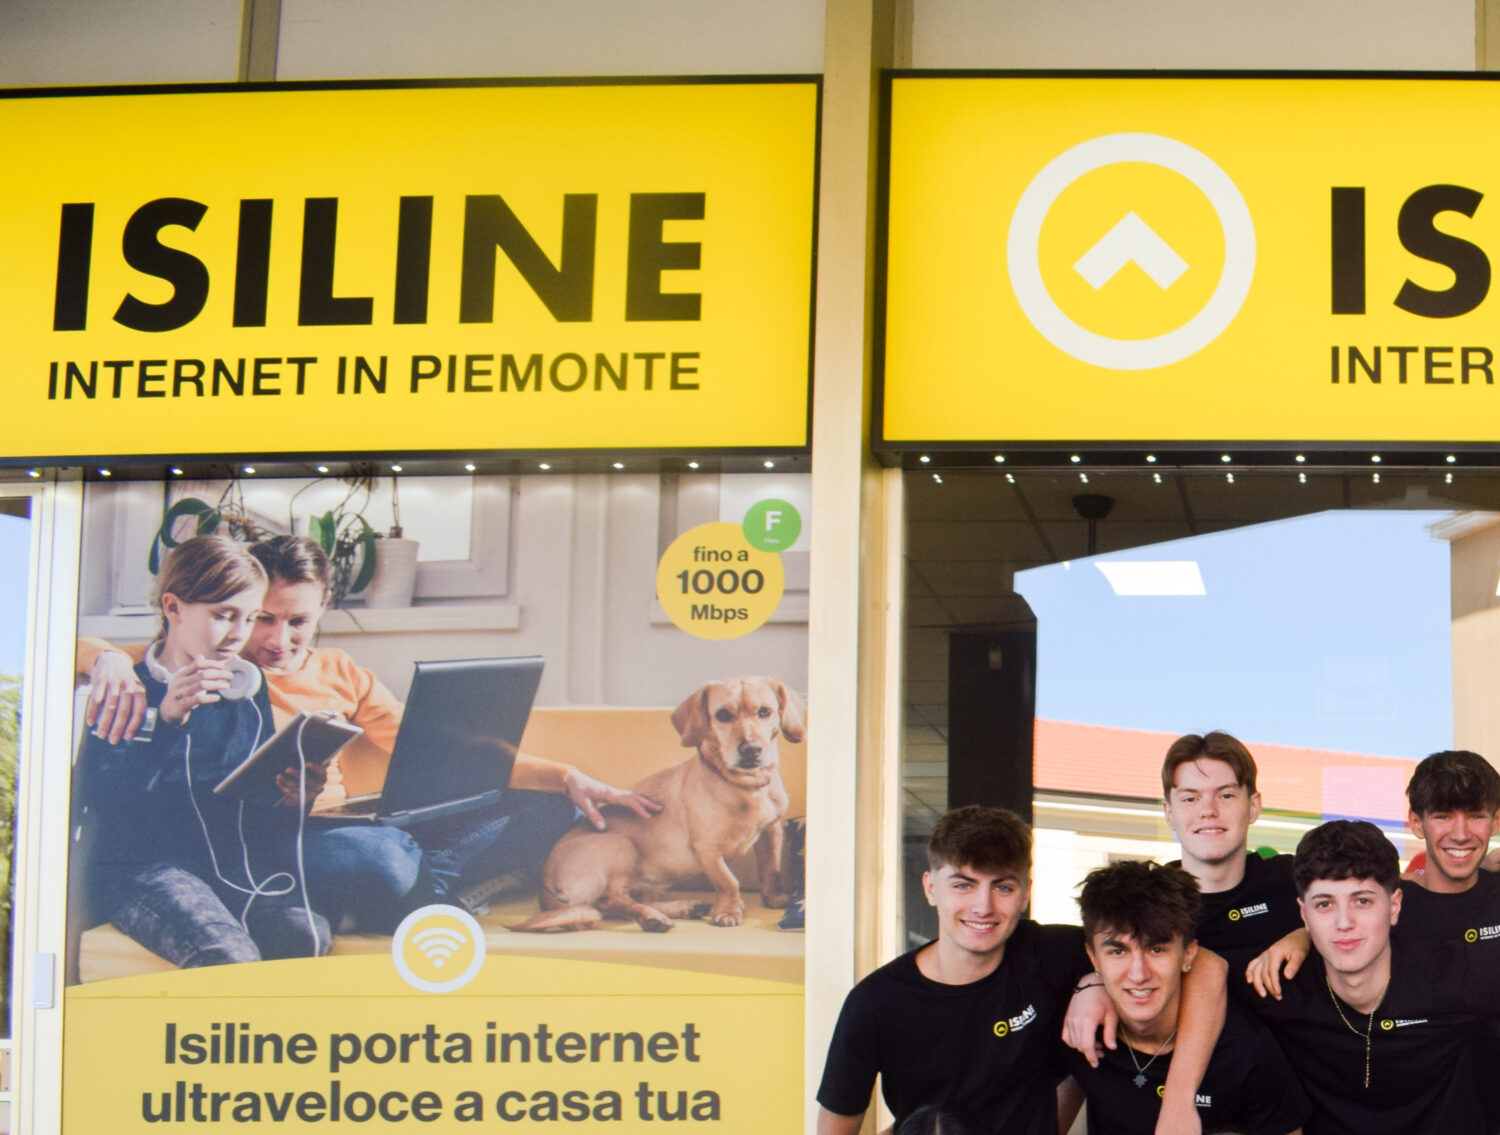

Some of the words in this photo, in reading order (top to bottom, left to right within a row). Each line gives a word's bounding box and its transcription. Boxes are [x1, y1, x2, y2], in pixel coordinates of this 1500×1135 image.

[53, 192, 706, 333] ISILINE
[47, 356, 318, 400] INTERNET
[336, 355, 388, 395] IN
[409, 351, 701, 394] PIEMONTE
[765, 510, 782, 532] F
[692, 545, 733, 562] fino
[736, 550, 749, 562] a
[676, 568, 765, 595] 1000
[690, 603, 749, 624] Mbps
[164, 1023, 318, 1064] Isiline
[329, 1024, 473, 1073] porta
[485, 1021, 701, 1064] internet
[141, 1080, 443, 1124] ultraveloce
[453, 1091, 484, 1123] a
[495, 1090, 623, 1123] casa
[634, 1081, 722, 1123] tua
